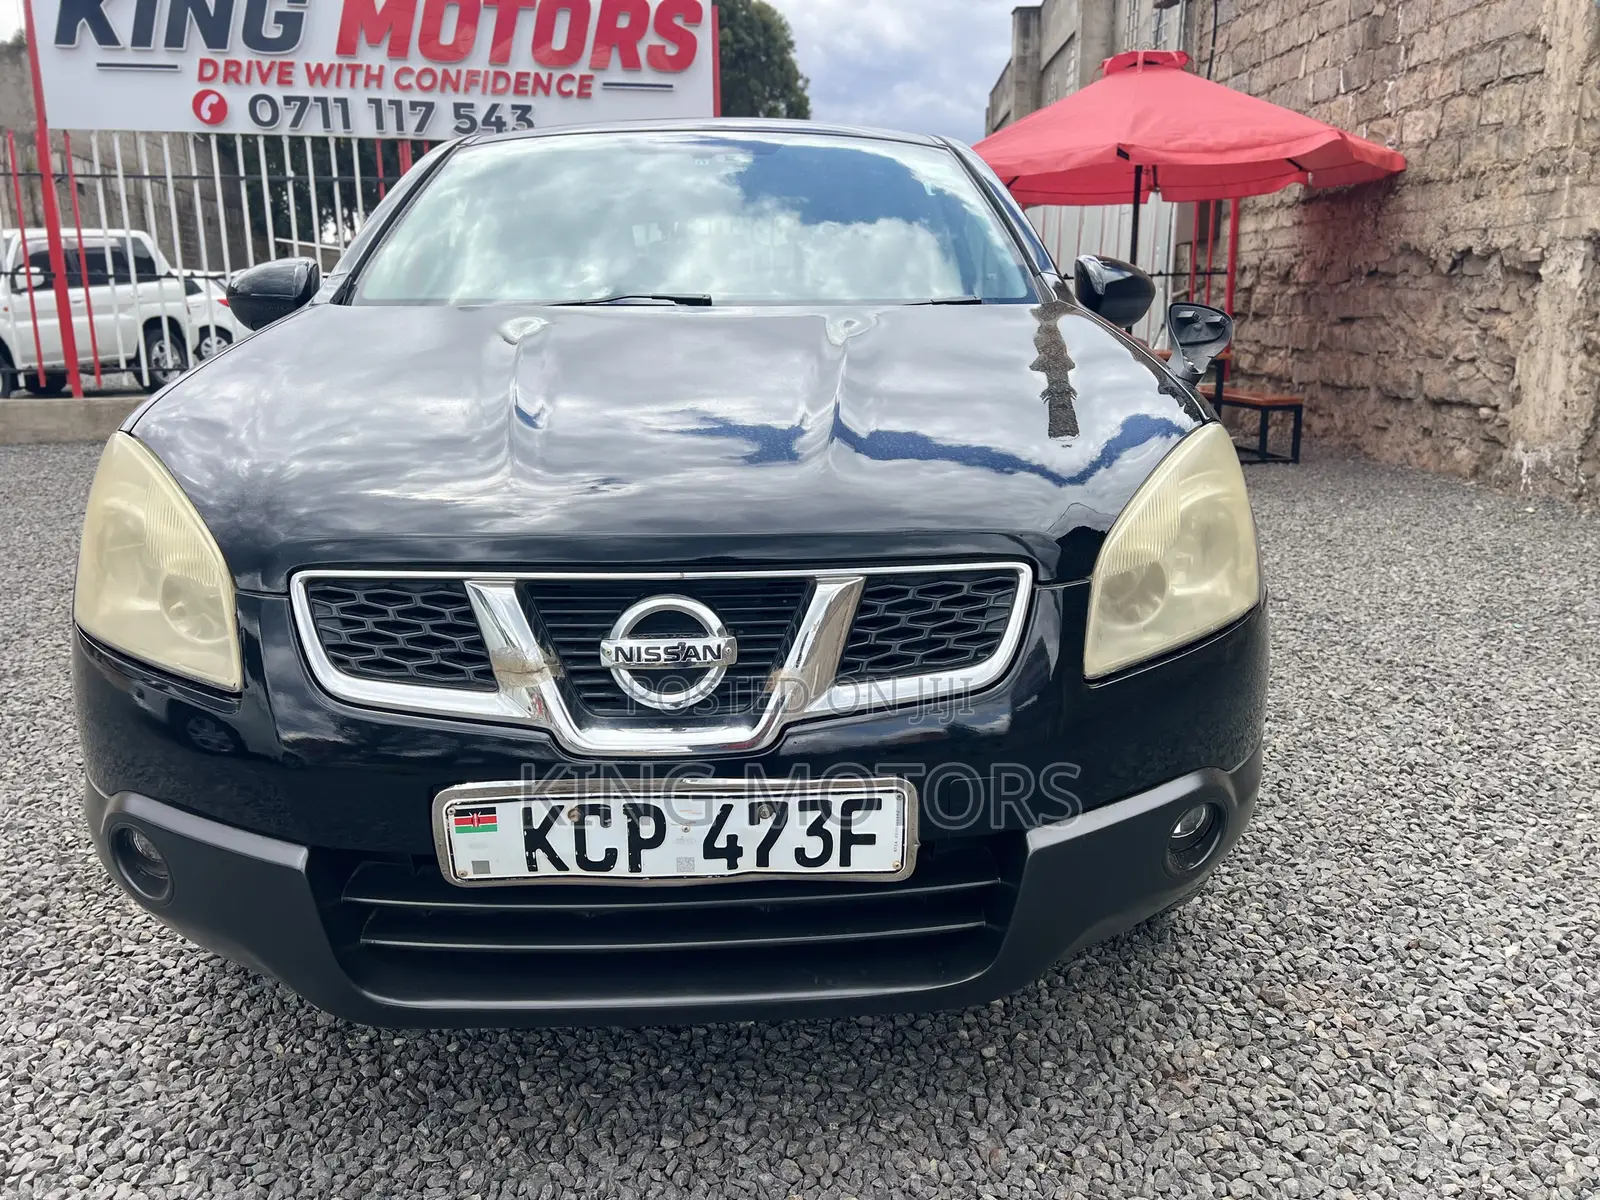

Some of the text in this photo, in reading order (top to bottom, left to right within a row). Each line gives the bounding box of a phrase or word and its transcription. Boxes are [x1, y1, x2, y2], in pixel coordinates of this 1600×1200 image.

[54, 0, 703, 72] KING MOTORS
[196, 57, 595, 99] DRIVE WITH CONFIDENCE
[248, 93, 536, 136] 0711 117 543
[613, 643, 723, 664] NISSAN
[521, 802, 667, 874] KCP
[703, 797, 883, 871] 473F
